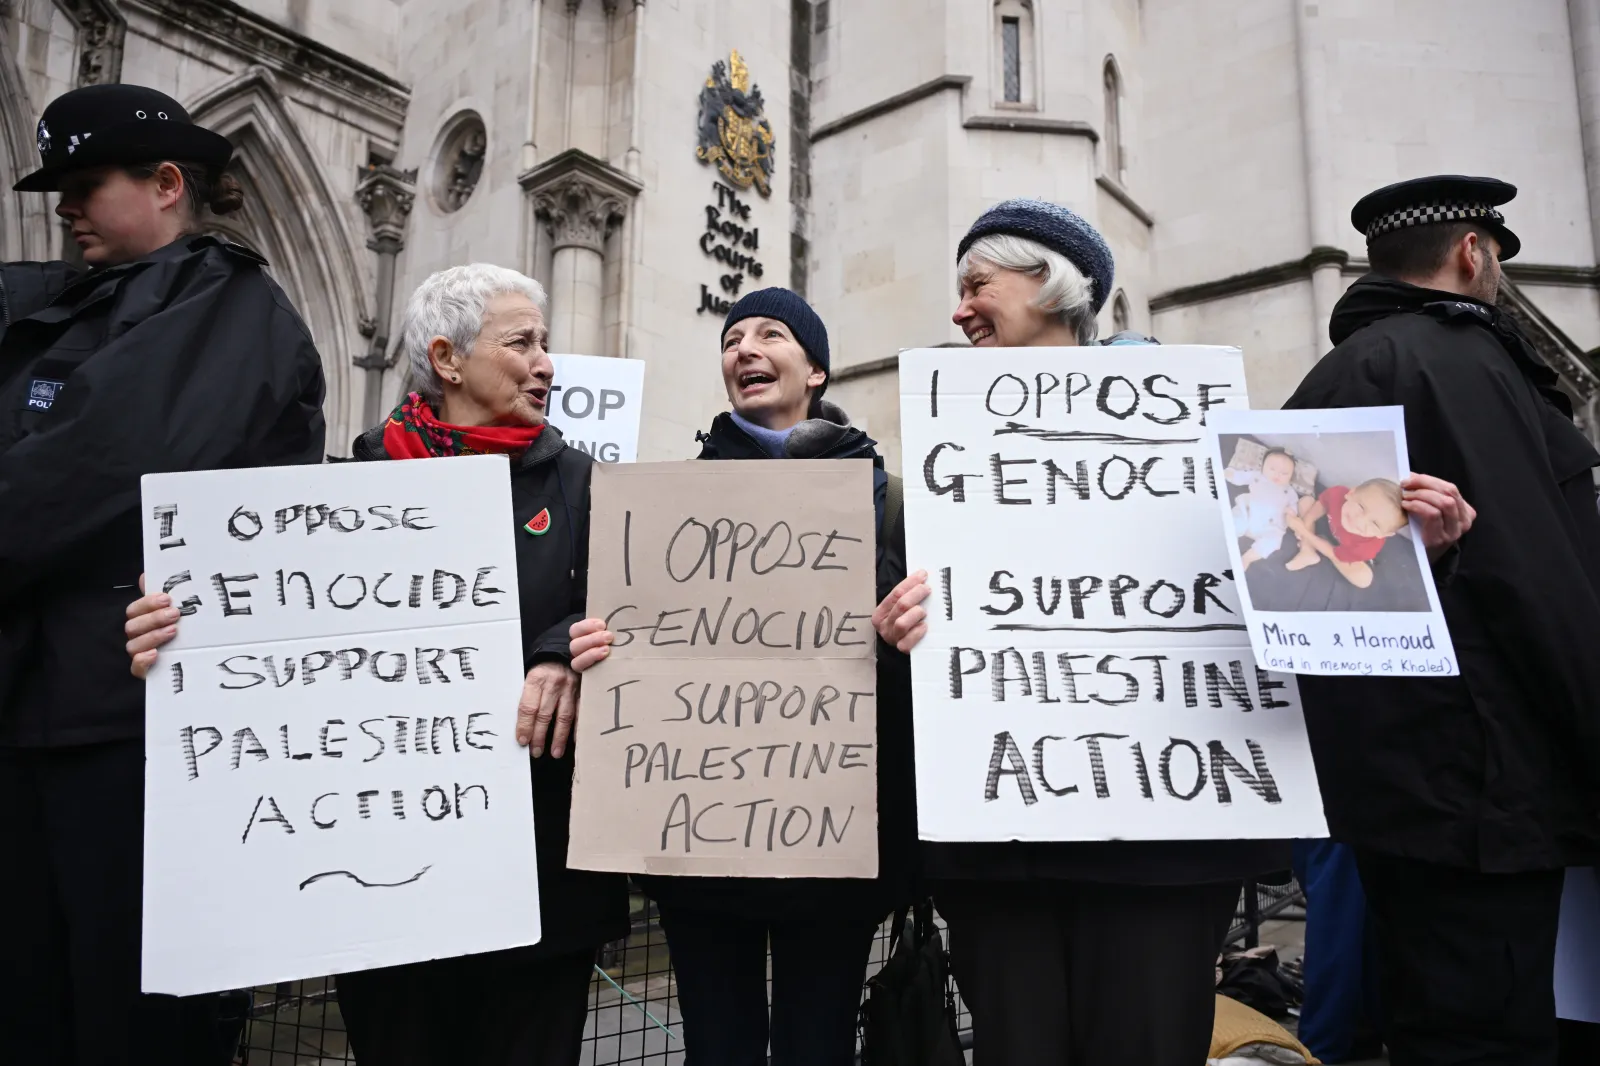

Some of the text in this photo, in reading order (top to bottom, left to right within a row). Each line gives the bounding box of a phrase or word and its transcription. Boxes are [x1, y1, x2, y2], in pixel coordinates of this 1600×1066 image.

[713, 181, 751, 221] The
[705, 205, 759, 250] Royal
[700, 232, 763, 278] Courts
[697, 284, 736, 316] Jus
[720, 273, 743, 295] of
[931, 369, 939, 418] I
[154, 503, 438, 551] I OPPOSE
[624, 510, 863, 587] I OPPOSE
[939, 566, 1236, 622] I SUPPOR
[603, 596, 872, 651] GENOCIDE
[1262, 622, 1311, 647] Mira
[172, 646, 480, 695] I SUPPORT
[949, 645, 1292, 713] PALESTINE
[1381, 659, 1394, 673] of
[1401, 656, 1453, 675] Khaled)
[600, 679, 875, 736] I SUPPORT
[624, 741, 874, 789] PALESTINE
[984, 730, 1282, 807] ACTION
[660, 792, 855, 853] ACTION
